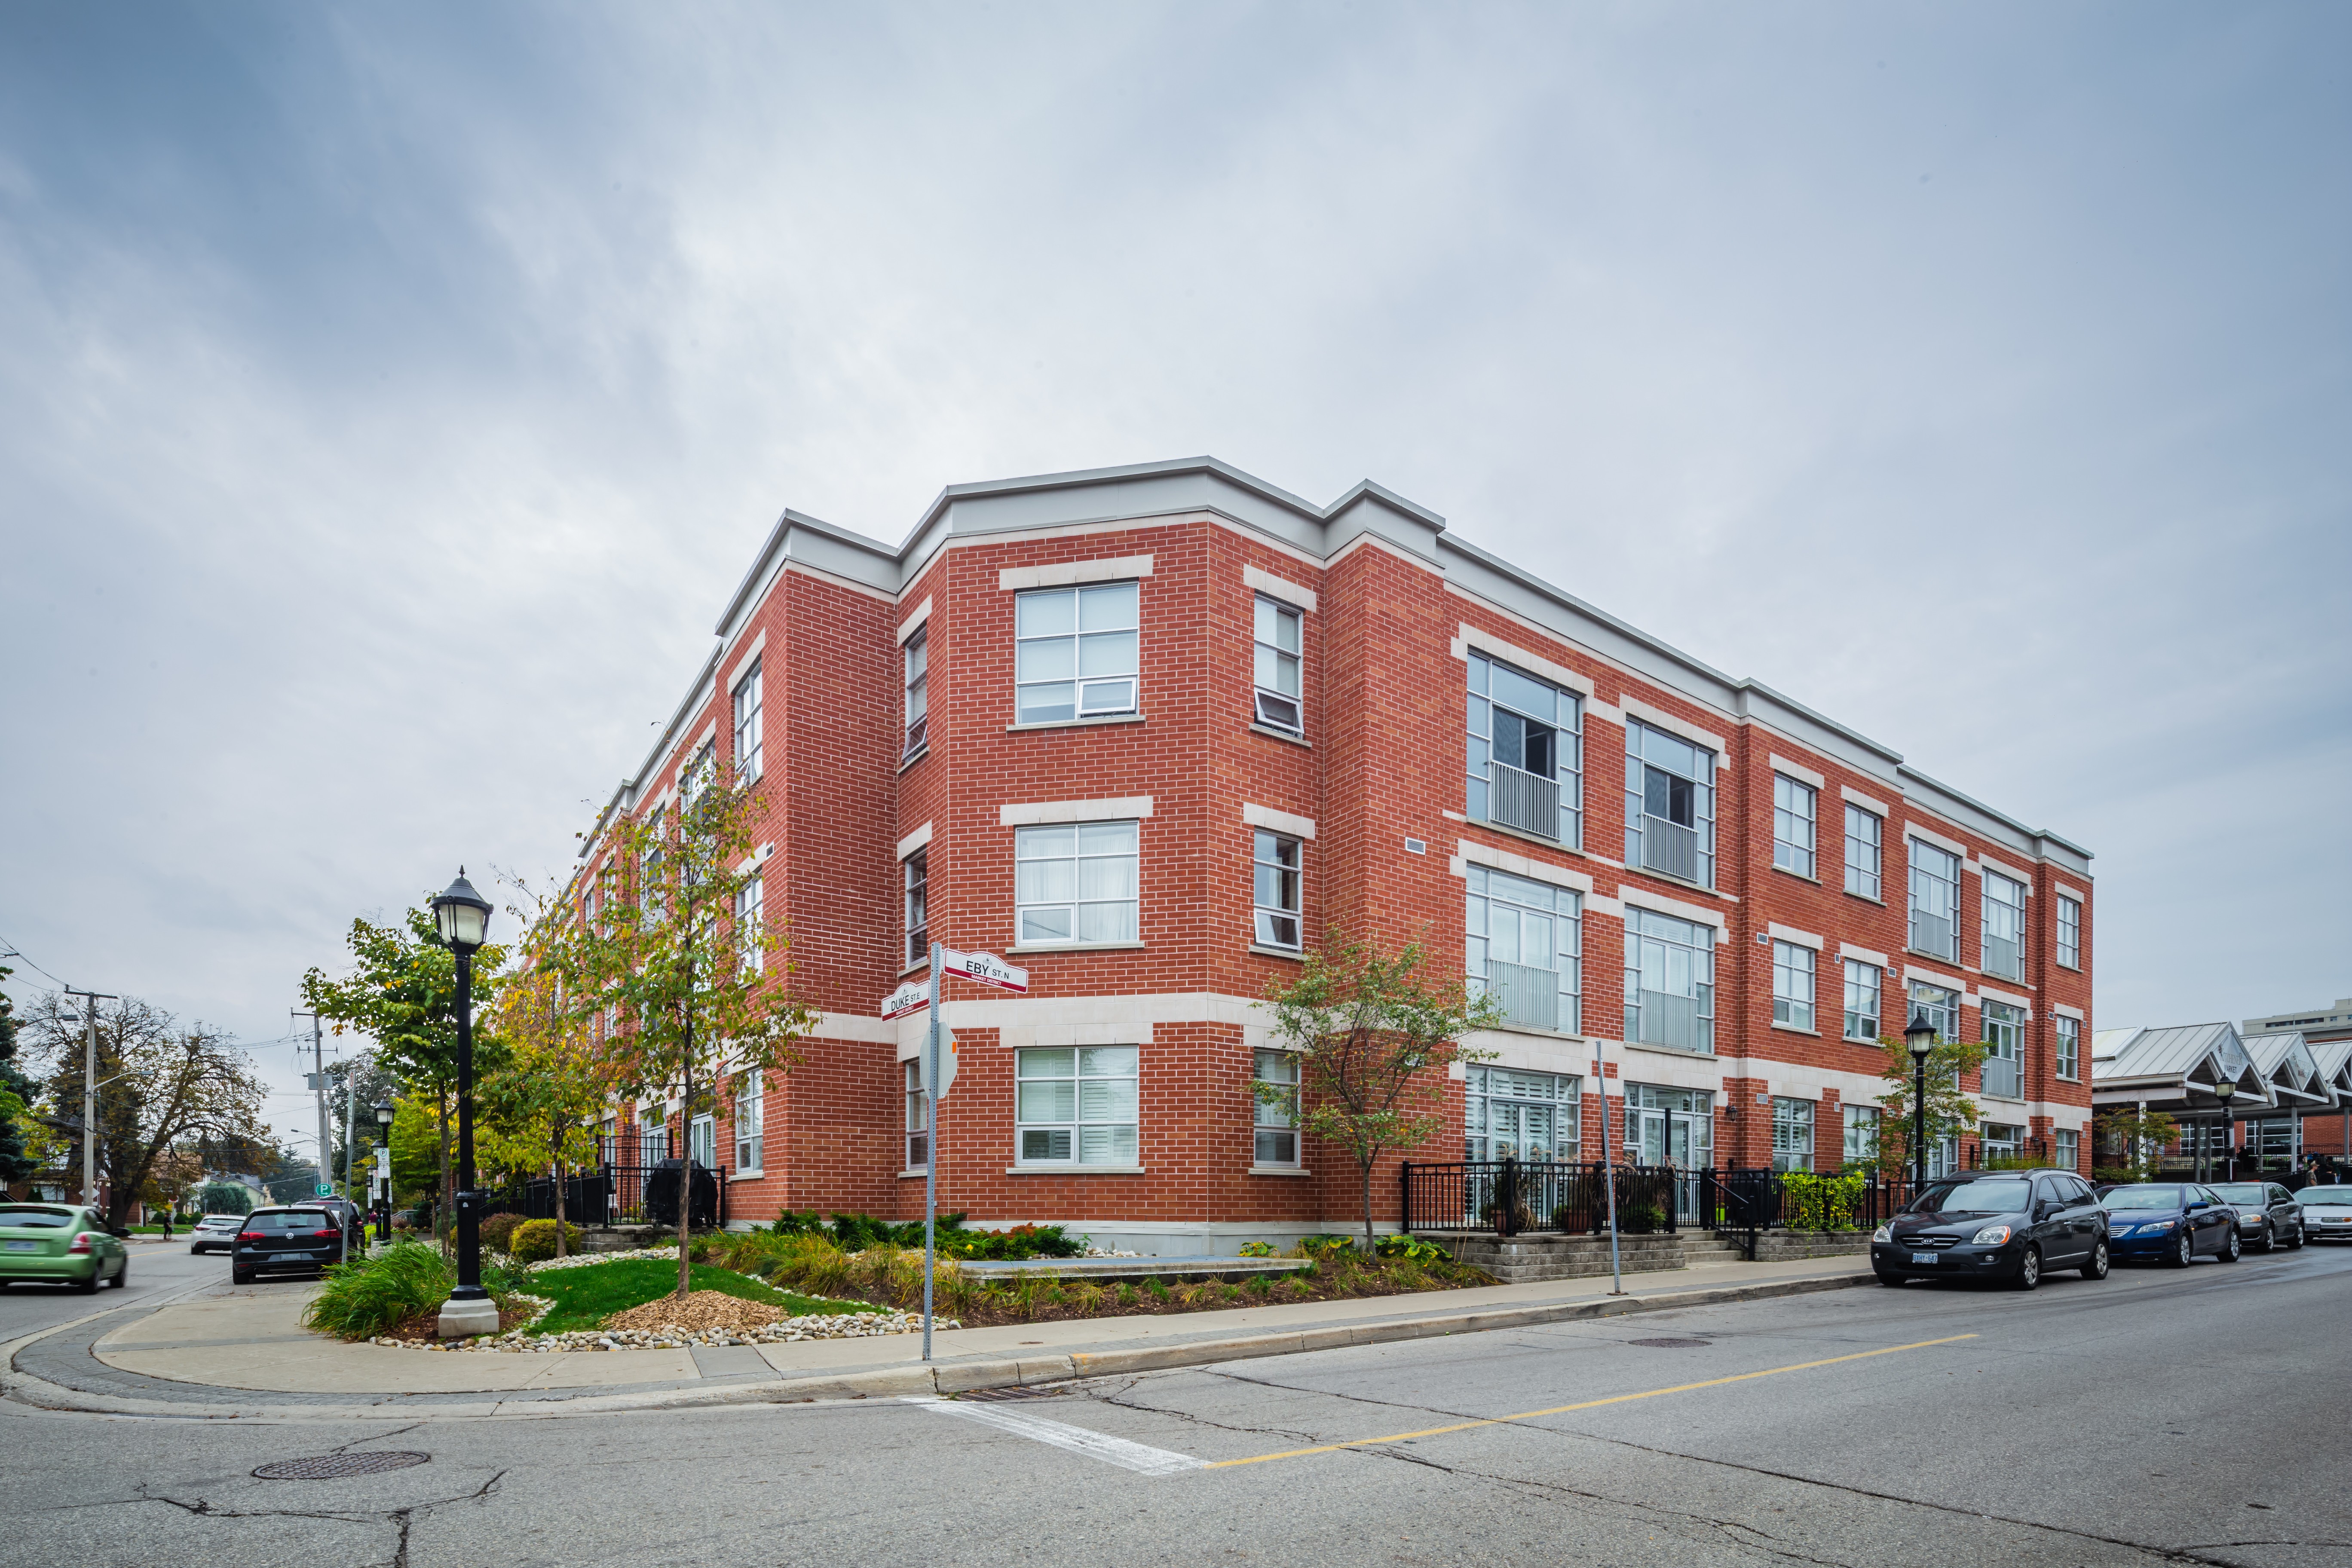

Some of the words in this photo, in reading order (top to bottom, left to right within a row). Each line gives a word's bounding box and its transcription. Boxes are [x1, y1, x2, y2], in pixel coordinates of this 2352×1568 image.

[966, 960, 989, 975] EBY
[891, 995, 909, 1011] DUKE
[321, 1185, 328, 1193] P
